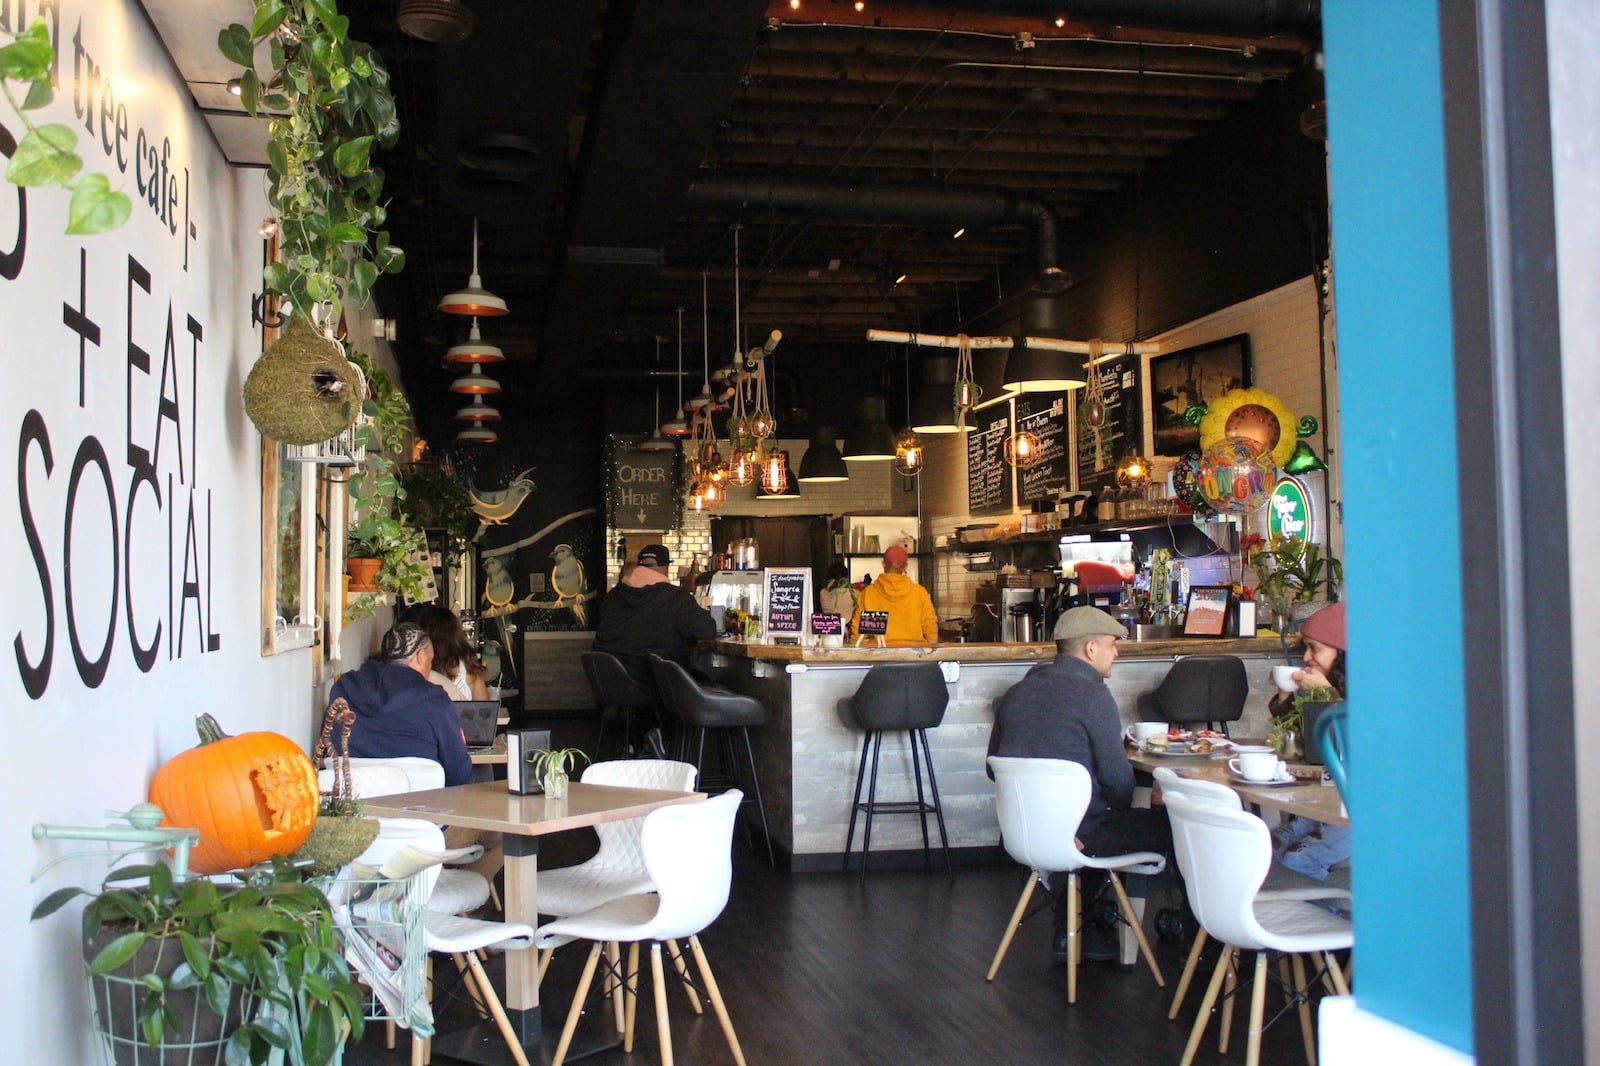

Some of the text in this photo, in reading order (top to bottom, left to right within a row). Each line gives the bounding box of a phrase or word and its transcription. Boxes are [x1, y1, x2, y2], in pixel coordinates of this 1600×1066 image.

[73, 15, 128, 173] tree
[136, 127, 177, 236] cafe
[127, 253, 202, 489] EAT
[14, 408, 220, 700] SOCIAL
[771, 581, 800, 597] Sangria
